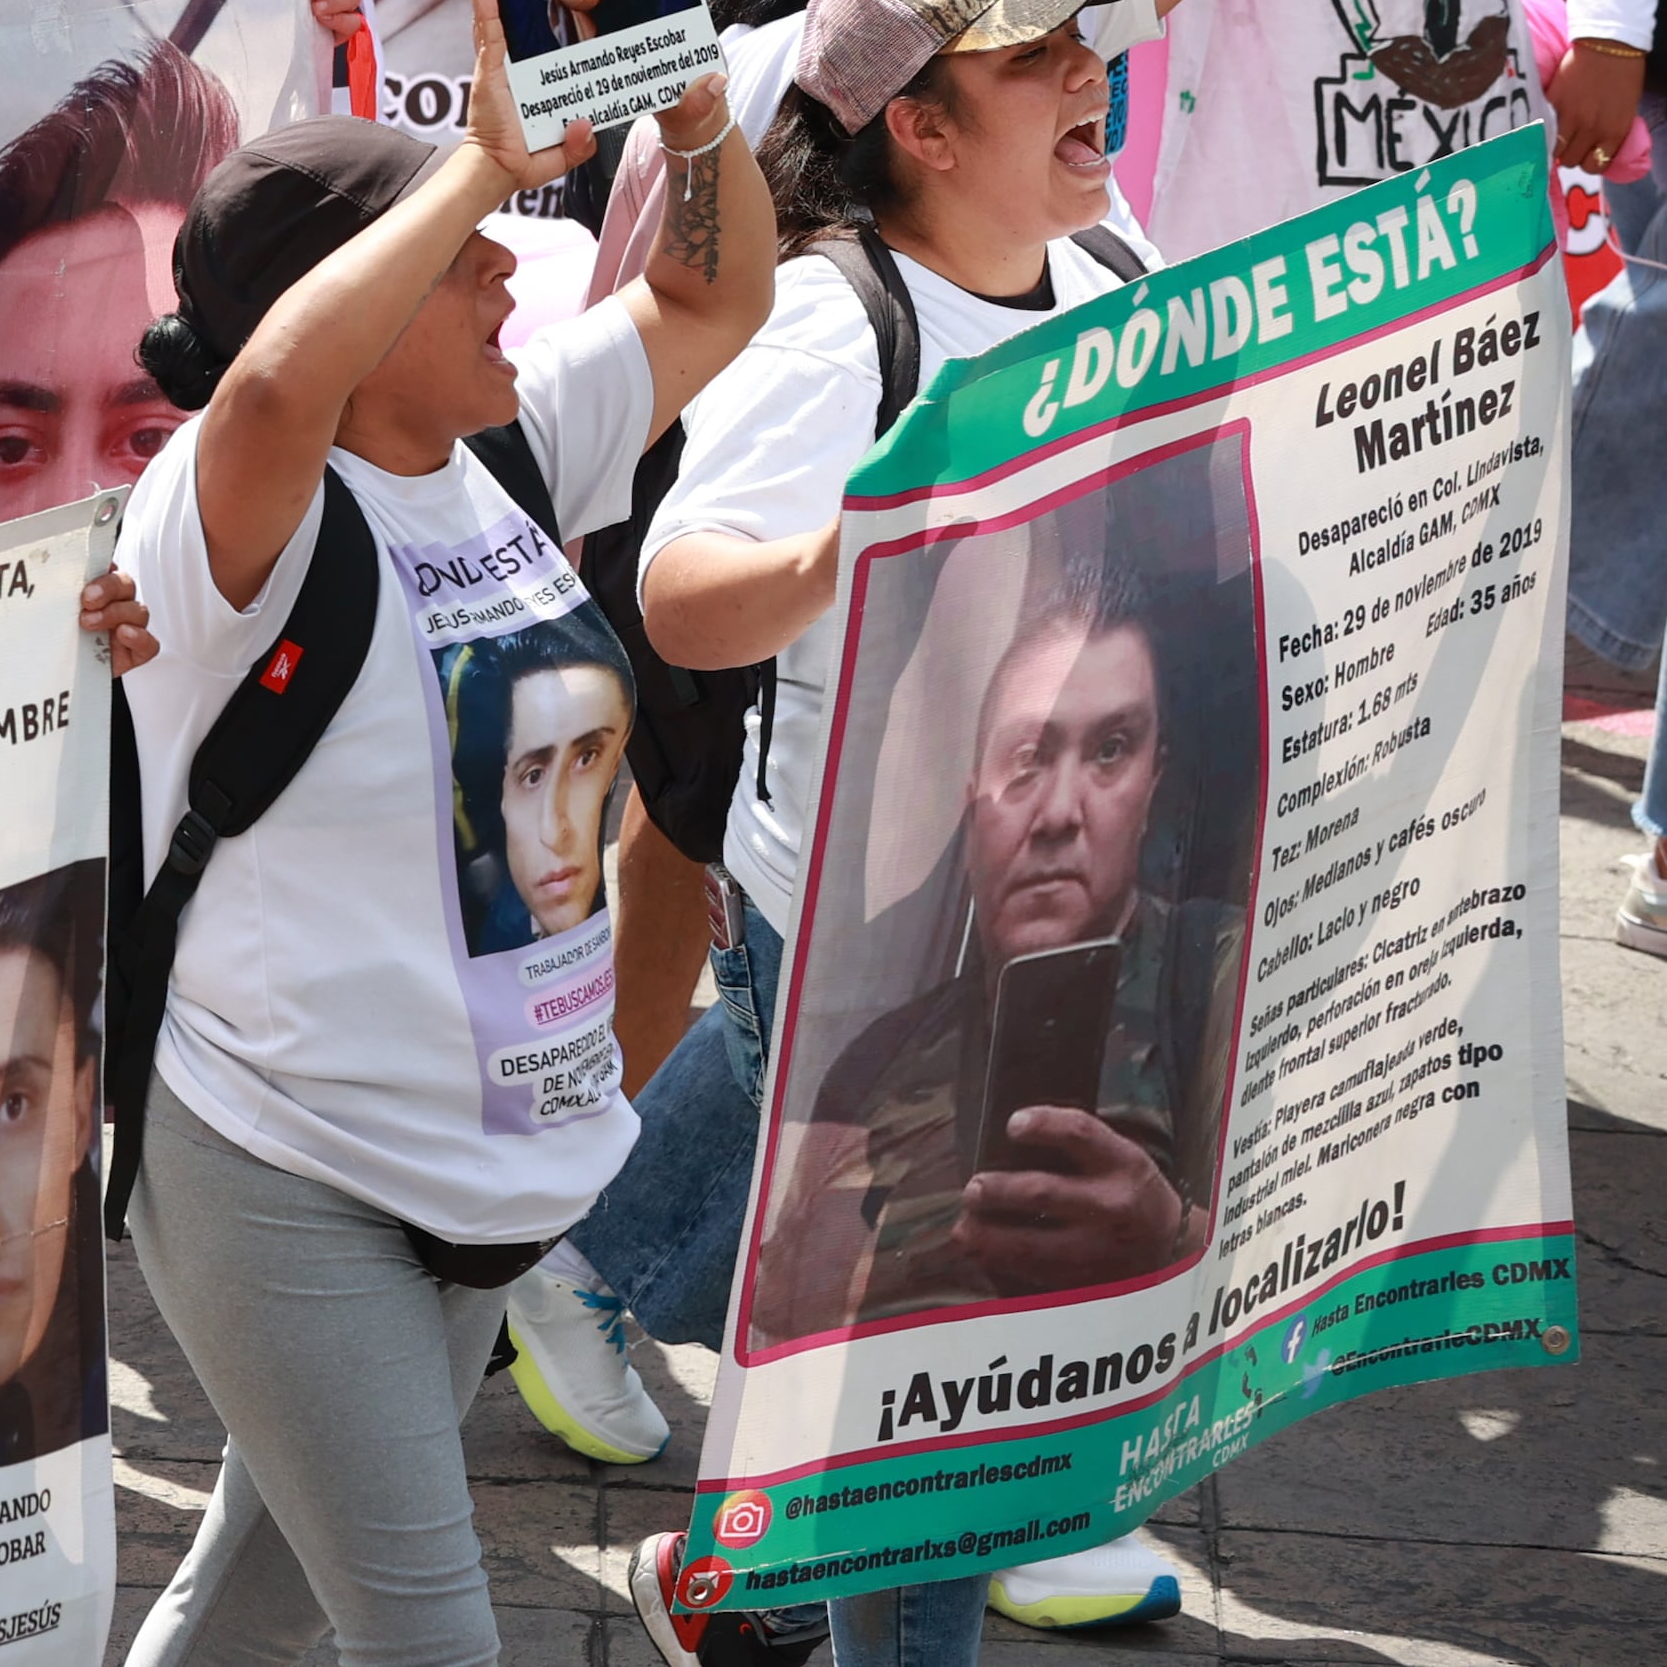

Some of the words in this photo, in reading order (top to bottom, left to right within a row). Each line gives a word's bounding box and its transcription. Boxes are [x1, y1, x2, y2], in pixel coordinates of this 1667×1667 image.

[539, 60, 569, 87] Jesús
[569, 47, 617, 77] Armando
[616, 39, 647, 65] Reyes
[646, 27, 687, 53] Escobar
[1021, 256, 1293, 438] ¿DÓNDE
[1304, 171, 1479, 323] ESTÁ?
[1315, 339, 1443, 430] Leonel
[1447, 308, 1543, 374] Báez
[1353, 377, 1518, 476] Martínez
[1298, 491, 1404, 557] Desapareció
[1408, 488, 1428, 512] en
[1433, 470, 1463, 502] Col.
[1466, 434, 1545, 488] Lindavista,
[1349, 531, 1415, 577] Alcaldía
[1419, 509, 1457, 547] GAM,
[1461, 482, 1502, 525] CDMX
[1278, 620, 1340, 663] Fecha:
[1343, 604, 1367, 638] 29
[1371, 595, 1391, 624] de
[1394, 553, 1467, 613] noviembre
[1470, 542, 1494, 568] de
[1499, 517, 1543, 559] 2019
[878, 1332, 1179, 1443] ¡Ayúdanos
[1181, 1311, 1203, 1354] a
[1206, 1179, 1409, 1337] localizarlo!
[784, 1446, 1075, 1522] @hastaencontrarlescdmx
